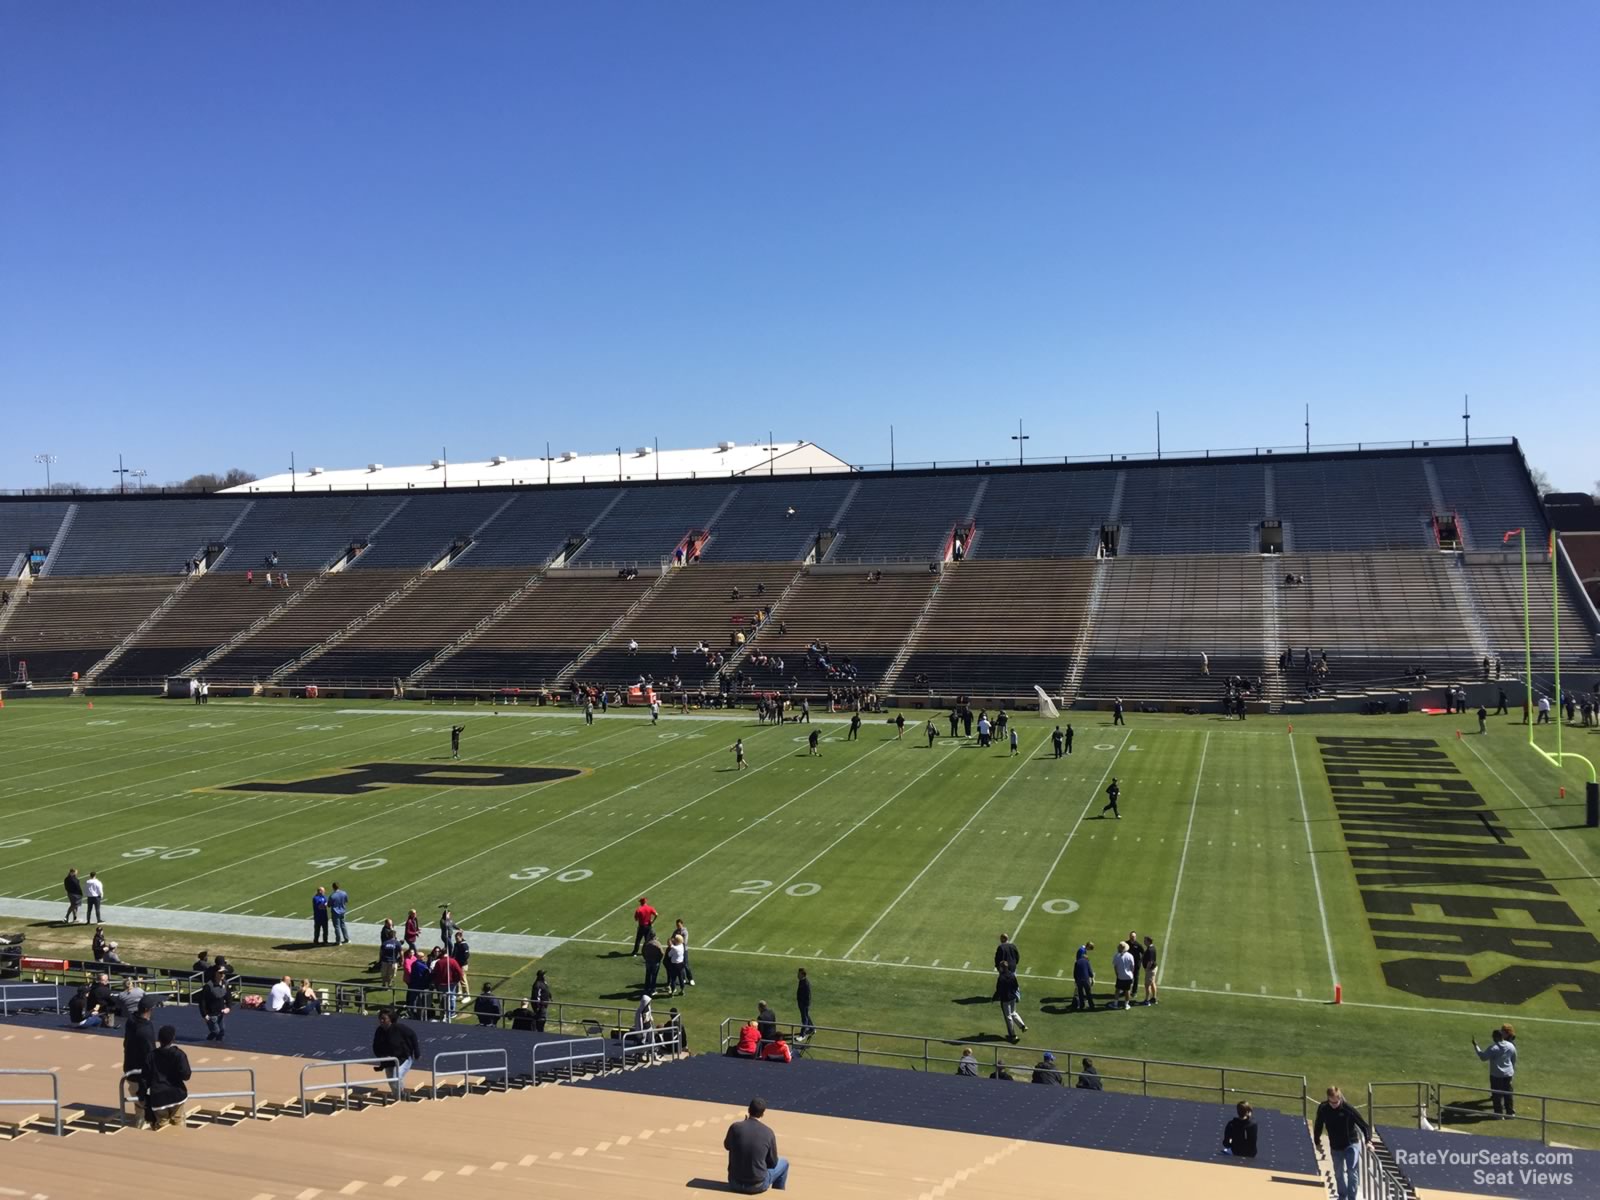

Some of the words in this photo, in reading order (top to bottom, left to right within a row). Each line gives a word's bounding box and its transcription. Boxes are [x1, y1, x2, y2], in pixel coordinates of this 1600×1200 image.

[121, 846, 201, 860] 50
[307, 855, 388, 871] 40
[509, 866, 594, 882] 30
[729, 879, 822, 897] 20
[995, 895, 1080, 914] 10
